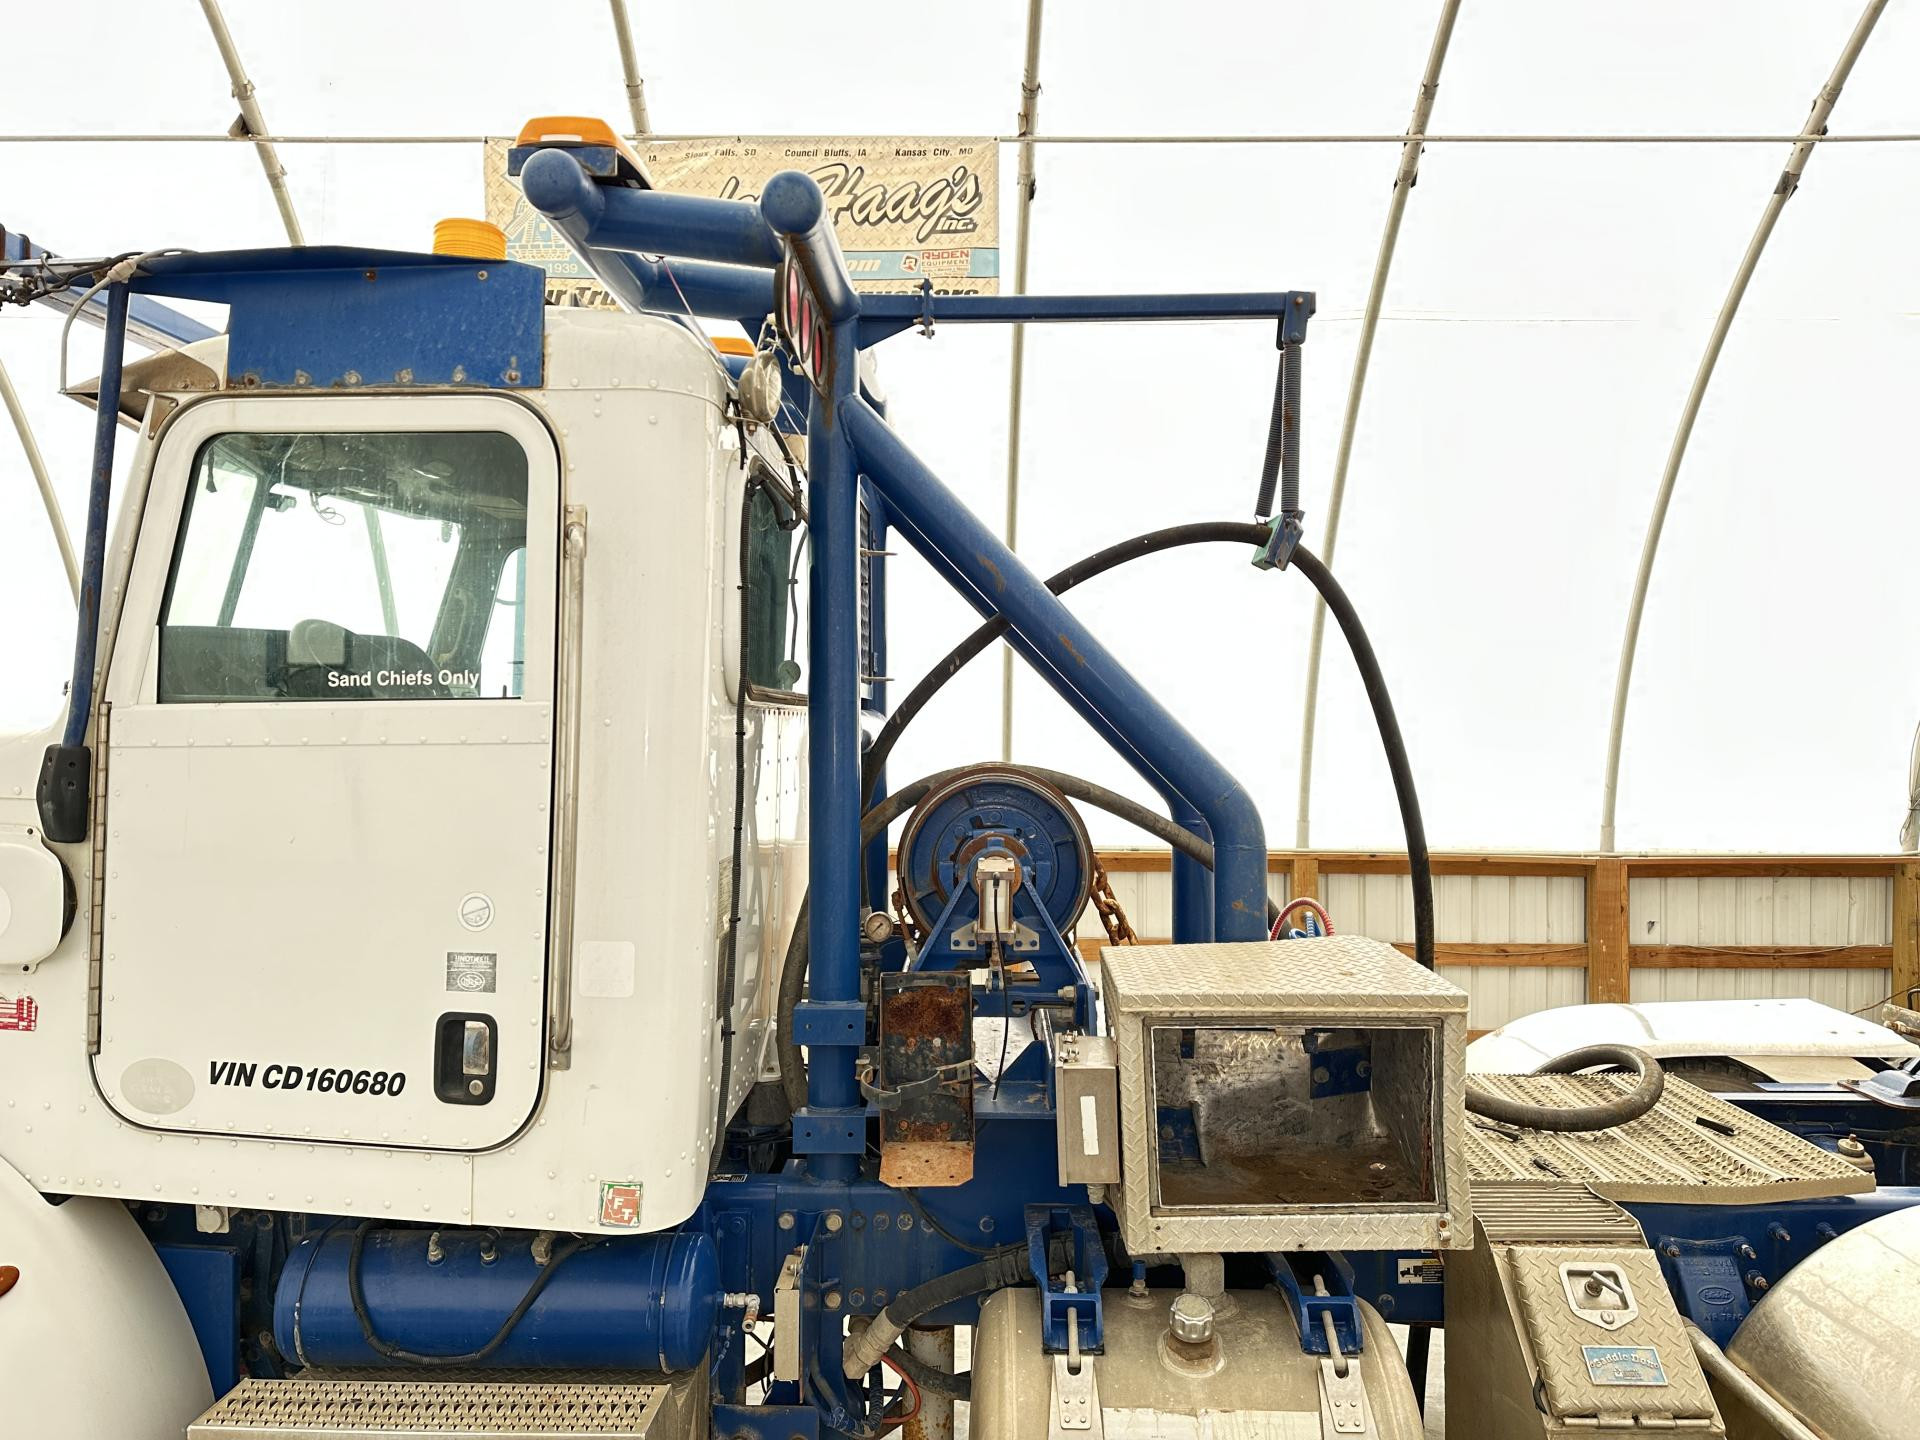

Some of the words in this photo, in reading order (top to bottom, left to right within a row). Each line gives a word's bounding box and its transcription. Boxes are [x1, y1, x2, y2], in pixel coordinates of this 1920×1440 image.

[784, 148, 818, 157] Council
[824, 148, 851, 158] Bluffs,
[857, 149, 867, 157] IA
[895, 149, 927, 157] Kansas
[959, 147, 973, 155] MO
[936, 216, 977, 232] Inc.
[922, 249, 969, 260] RYDEN
[547, 263, 578, 274] 1939
[575, 287, 618, 306] Tru
[327, 671, 372, 687] Sand
[377, 670, 433, 686] Chiefs
[438, 669, 479, 689] Only
[209, 1061, 257, 1087] VIN
[262, 1064, 407, 1097] CD160680
